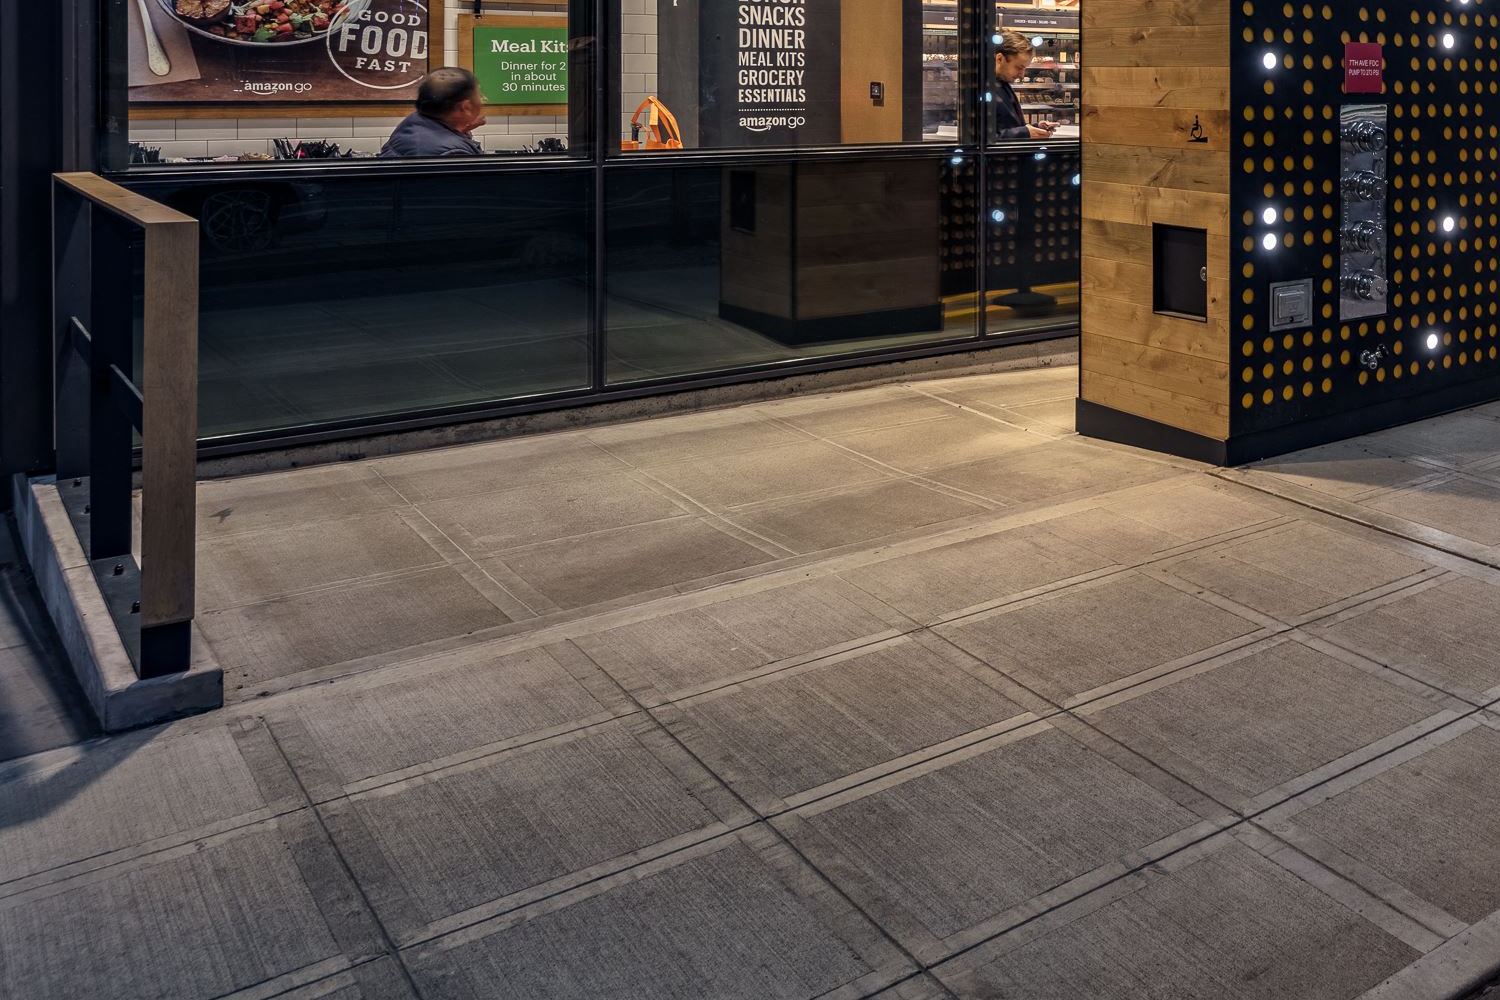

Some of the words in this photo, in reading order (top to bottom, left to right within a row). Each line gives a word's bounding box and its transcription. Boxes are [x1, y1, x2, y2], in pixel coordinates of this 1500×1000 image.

[358, 9, 421, 26] GOOD
[738, 5, 805, 26] SNACKS
[338, 23, 428, 60] FOOD
[491, 39, 537, 53] Meal
[738, 28, 805, 49] DINNER
[355, 57, 411, 73] FAST
[501, 61, 538, 71] Dinner
[541, 61, 557, 71] for
[559, 62, 567, 71] 2
[738, 52, 773, 67] MEAL
[776, 52, 805, 67] KITS
[511, 72, 521, 81] in
[524, 72, 557, 81] about
[738, 69, 805, 86] GROCERY
[244, 81, 293, 95] amazon
[294, 82, 312, 92] go
[502, 82, 518, 92] 30
[521, 82, 566, 92] minutes
[738, 88, 806, 103] ESSENTIALS
[739, 115, 787, 132] amazon
[788, 116, 805, 128] go
